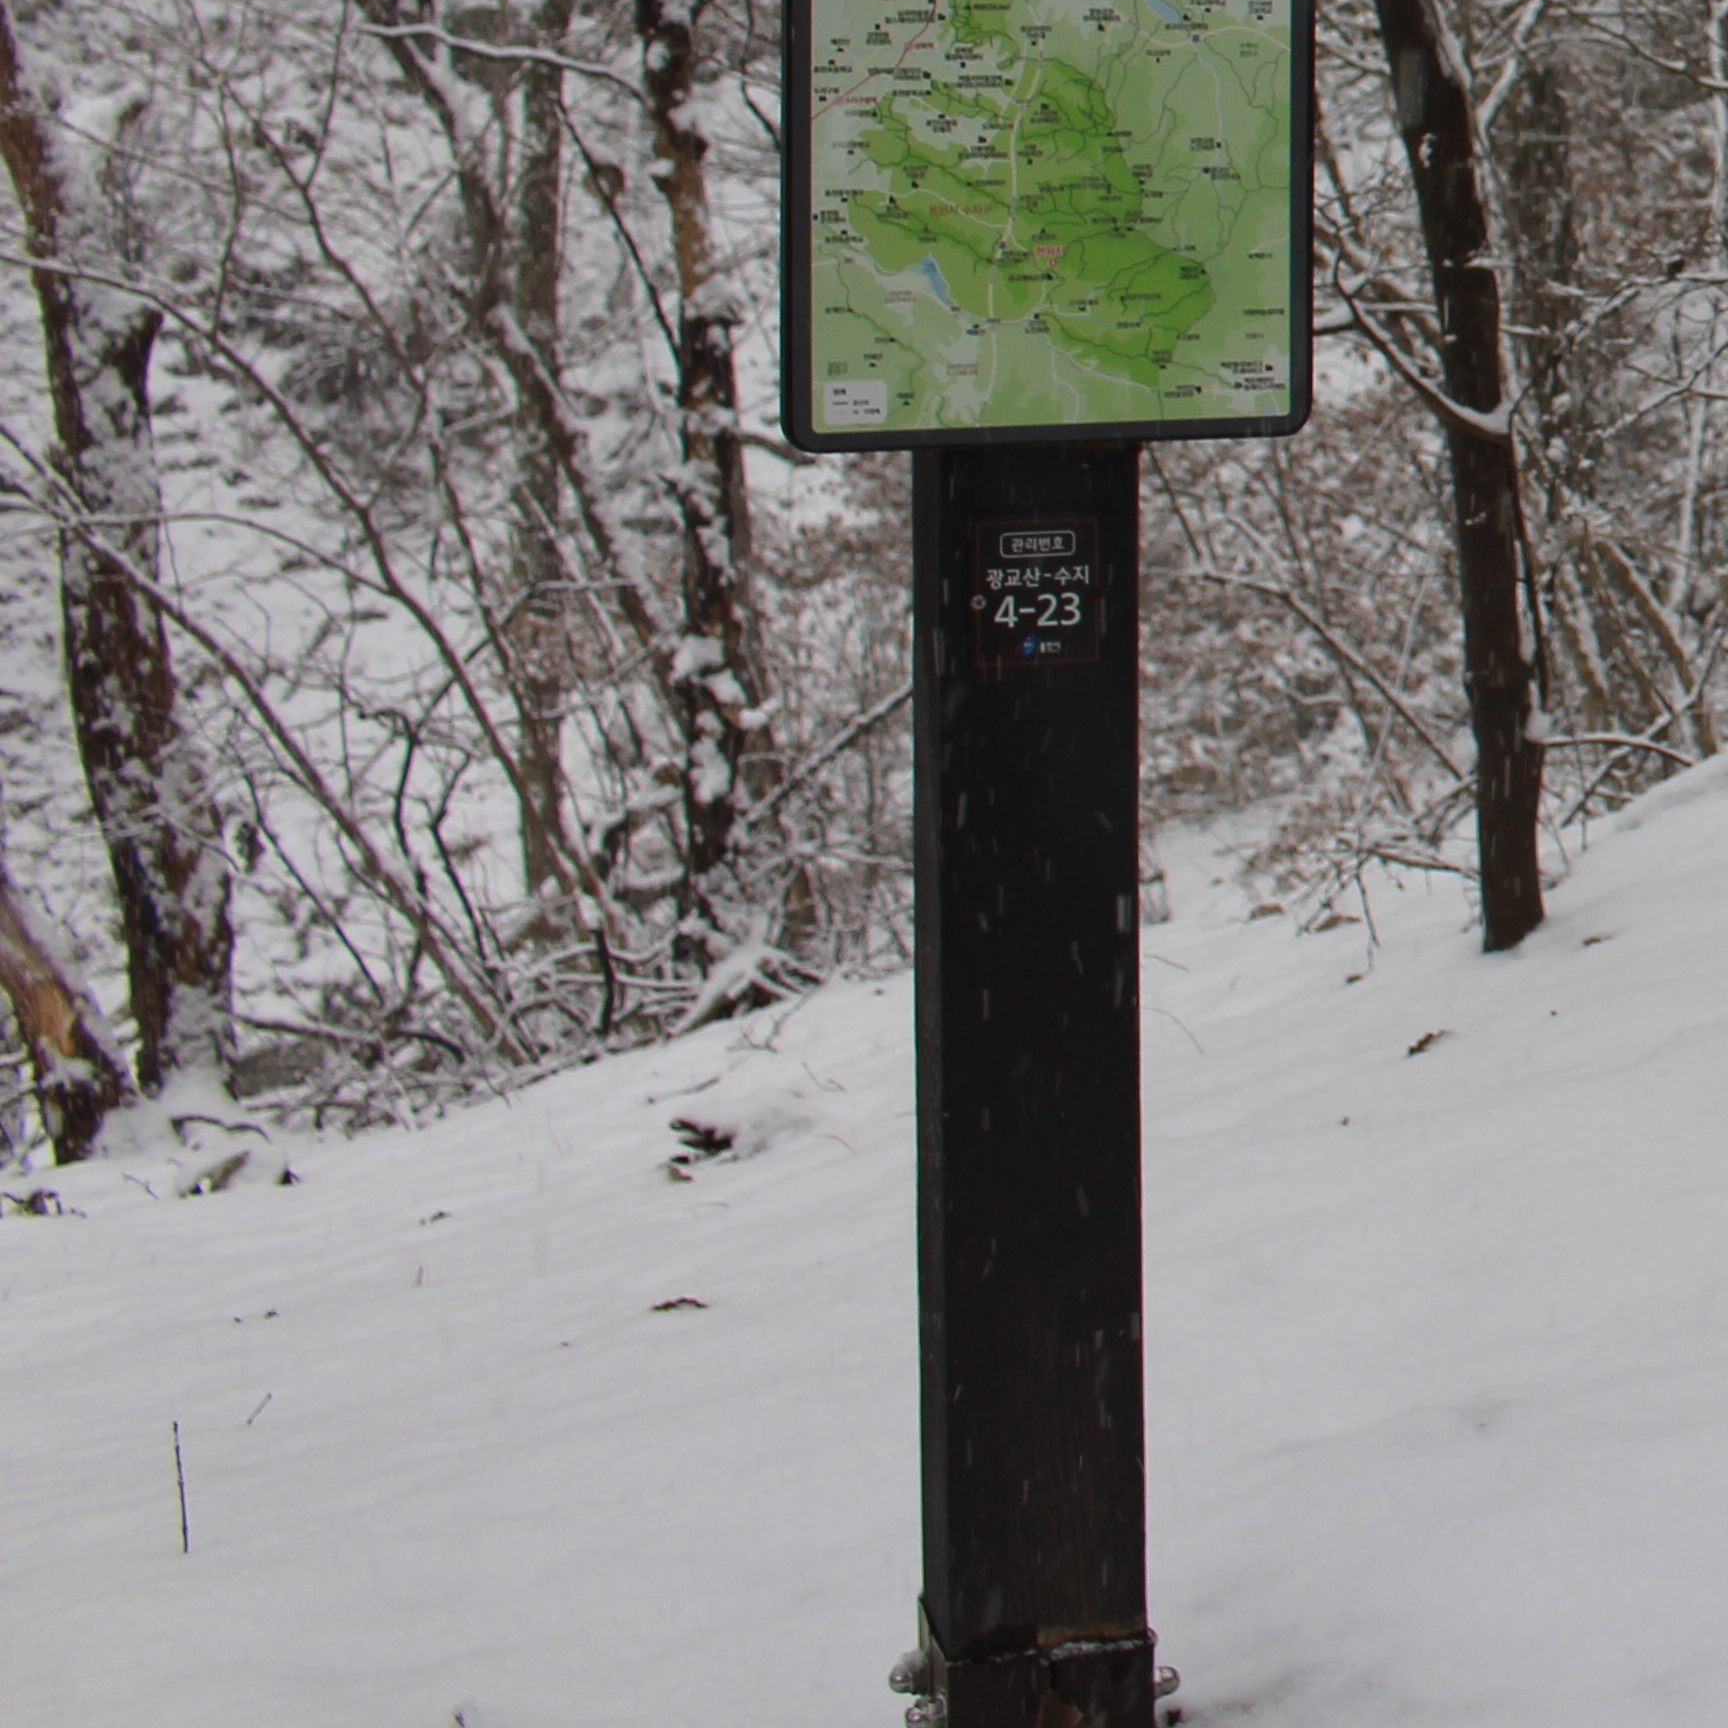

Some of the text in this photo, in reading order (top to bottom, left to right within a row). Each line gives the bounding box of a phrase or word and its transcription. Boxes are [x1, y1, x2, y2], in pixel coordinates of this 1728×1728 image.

[1011, 537, 1065, 553] 관리번호
[986, 565, 1090, 590] 광교산-수지
[994, 593, 1081, 629] 4-23
